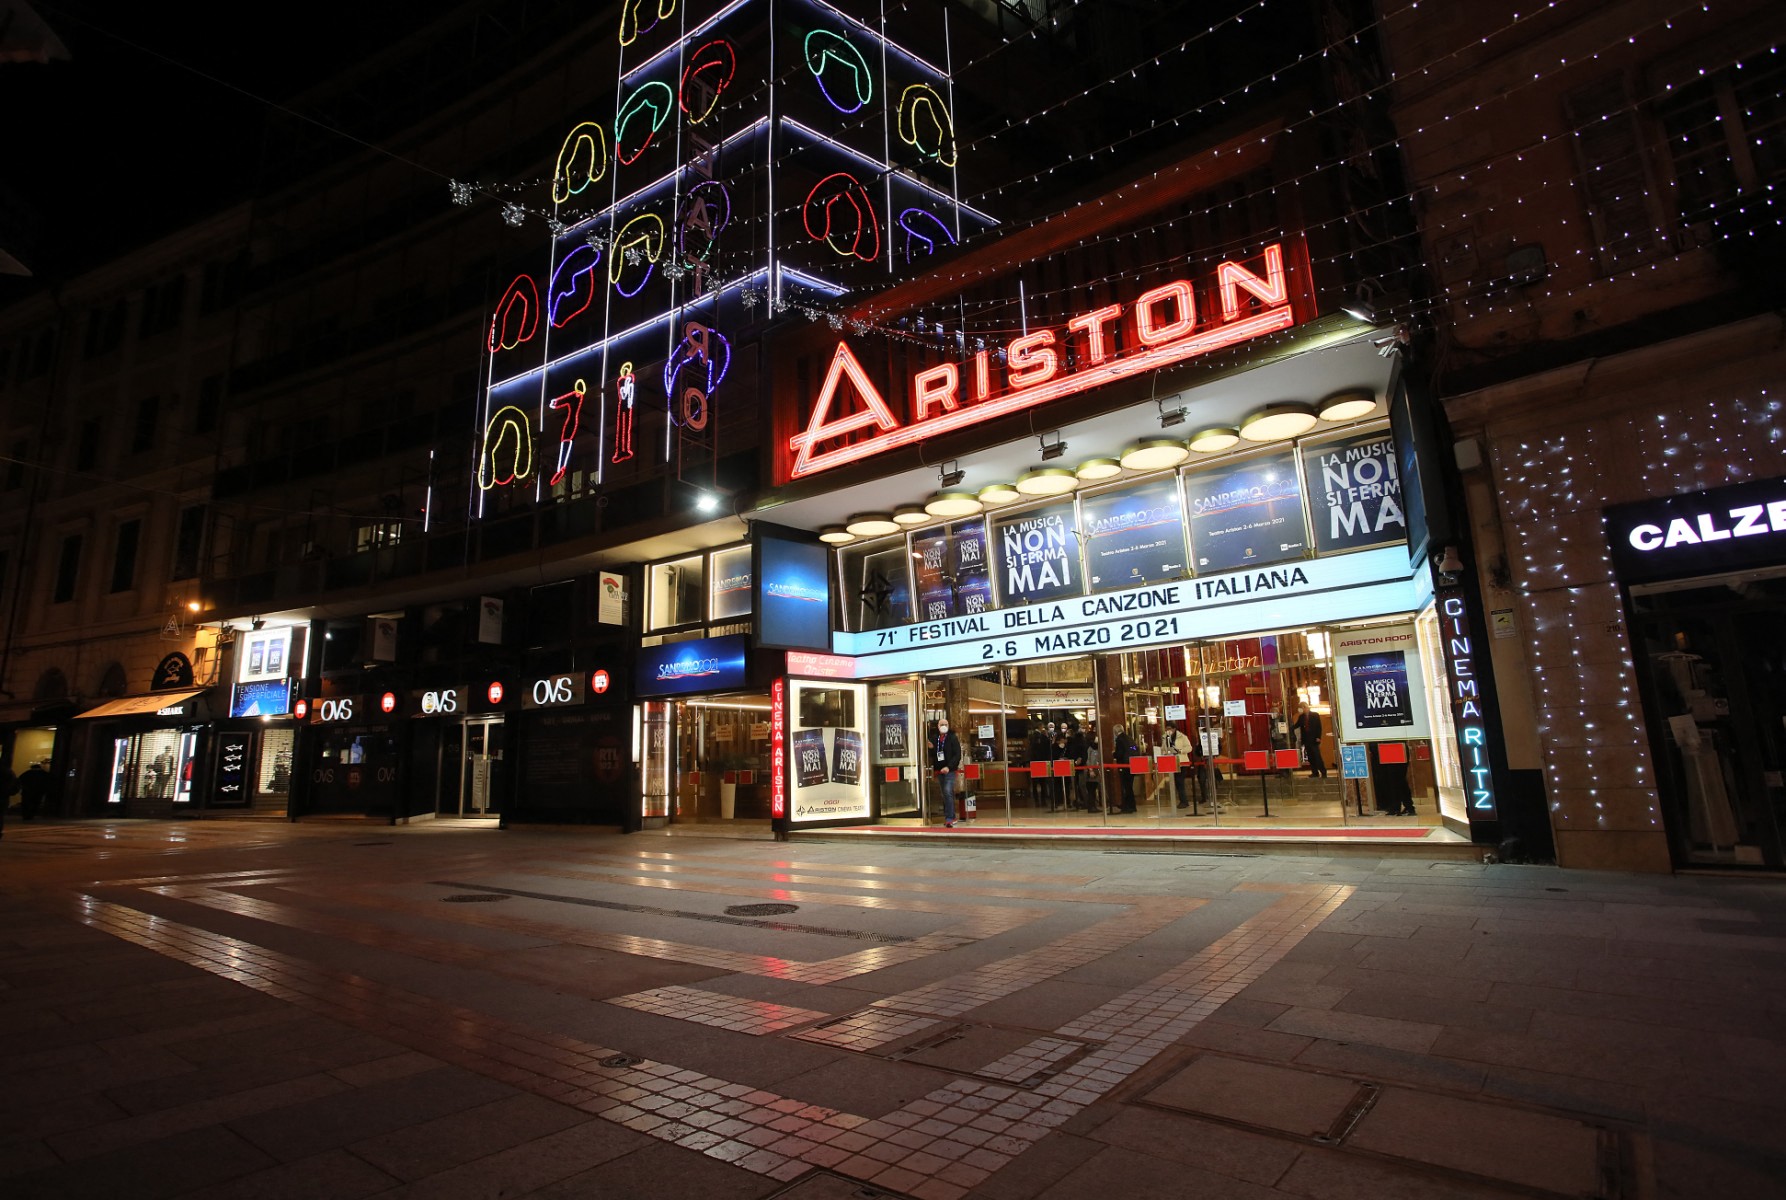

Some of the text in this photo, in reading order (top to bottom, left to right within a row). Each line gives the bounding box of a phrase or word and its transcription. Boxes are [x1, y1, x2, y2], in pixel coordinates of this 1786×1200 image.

[789, 243, 1294, 478] ARISTON
[1320, 441, 1395, 468] LA MUSIC
[1326, 479, 1401, 507] SI FERM
[1271, 517, 1285, 525] 2021
[1330, 495, 1406, 540] MA
[1003, 515, 1063, 537] LA MUSICA
[960, 541, 979, 551] NON
[1004, 524, 1066, 557] NON
[923, 550, 941, 559] NON
[961, 552, 980, 563] MAI
[1006, 546, 1067, 568] SI FERMA
[924, 559, 942, 570] MAI
[1008, 557, 1071, 595] MAI
[909, 617, 989, 642] FESTIVAL
[1004, 606, 1064, 628] DELLA
[1082, 587, 1181, 617] CANZONE
[1195, 567, 1309, 600] ITALIANA
[929, 603, 947, 612] NON
[966, 597, 985, 606] NON
[1034, 627, 1110, 653] MARZO
[1120, 617, 1179, 641] 2021
[1339, 633, 1414, 648] ARISTON ROOF
[236, 683, 270, 695] TENSIONE
[532, 676, 573, 705] OVS
[1365, 682, 1396, 694] NON
[239, 689, 287, 702] SUPERFICIALE
[421, 689, 457, 714] OVS
[1367, 696, 1399, 709] MAI
[1444, 598, 1480, 719] CINEMA
[1464, 727, 1493, 810] RITZ
[320, 698, 353, 721] OVS
[885, 727, 902, 735] NON
[774, 682, 784, 812] CINEMA ARISTON
[886, 736, 902, 745] MAI
[599, 747, 618, 761] RTL
[802, 751, 820, 761] NON
[840, 751, 857, 761] NON
[803, 762, 821, 773] MAI
[839, 762, 856, 771] MAI
[313, 768, 335, 784] OVS
[807, 805, 837, 814] ARISTON
